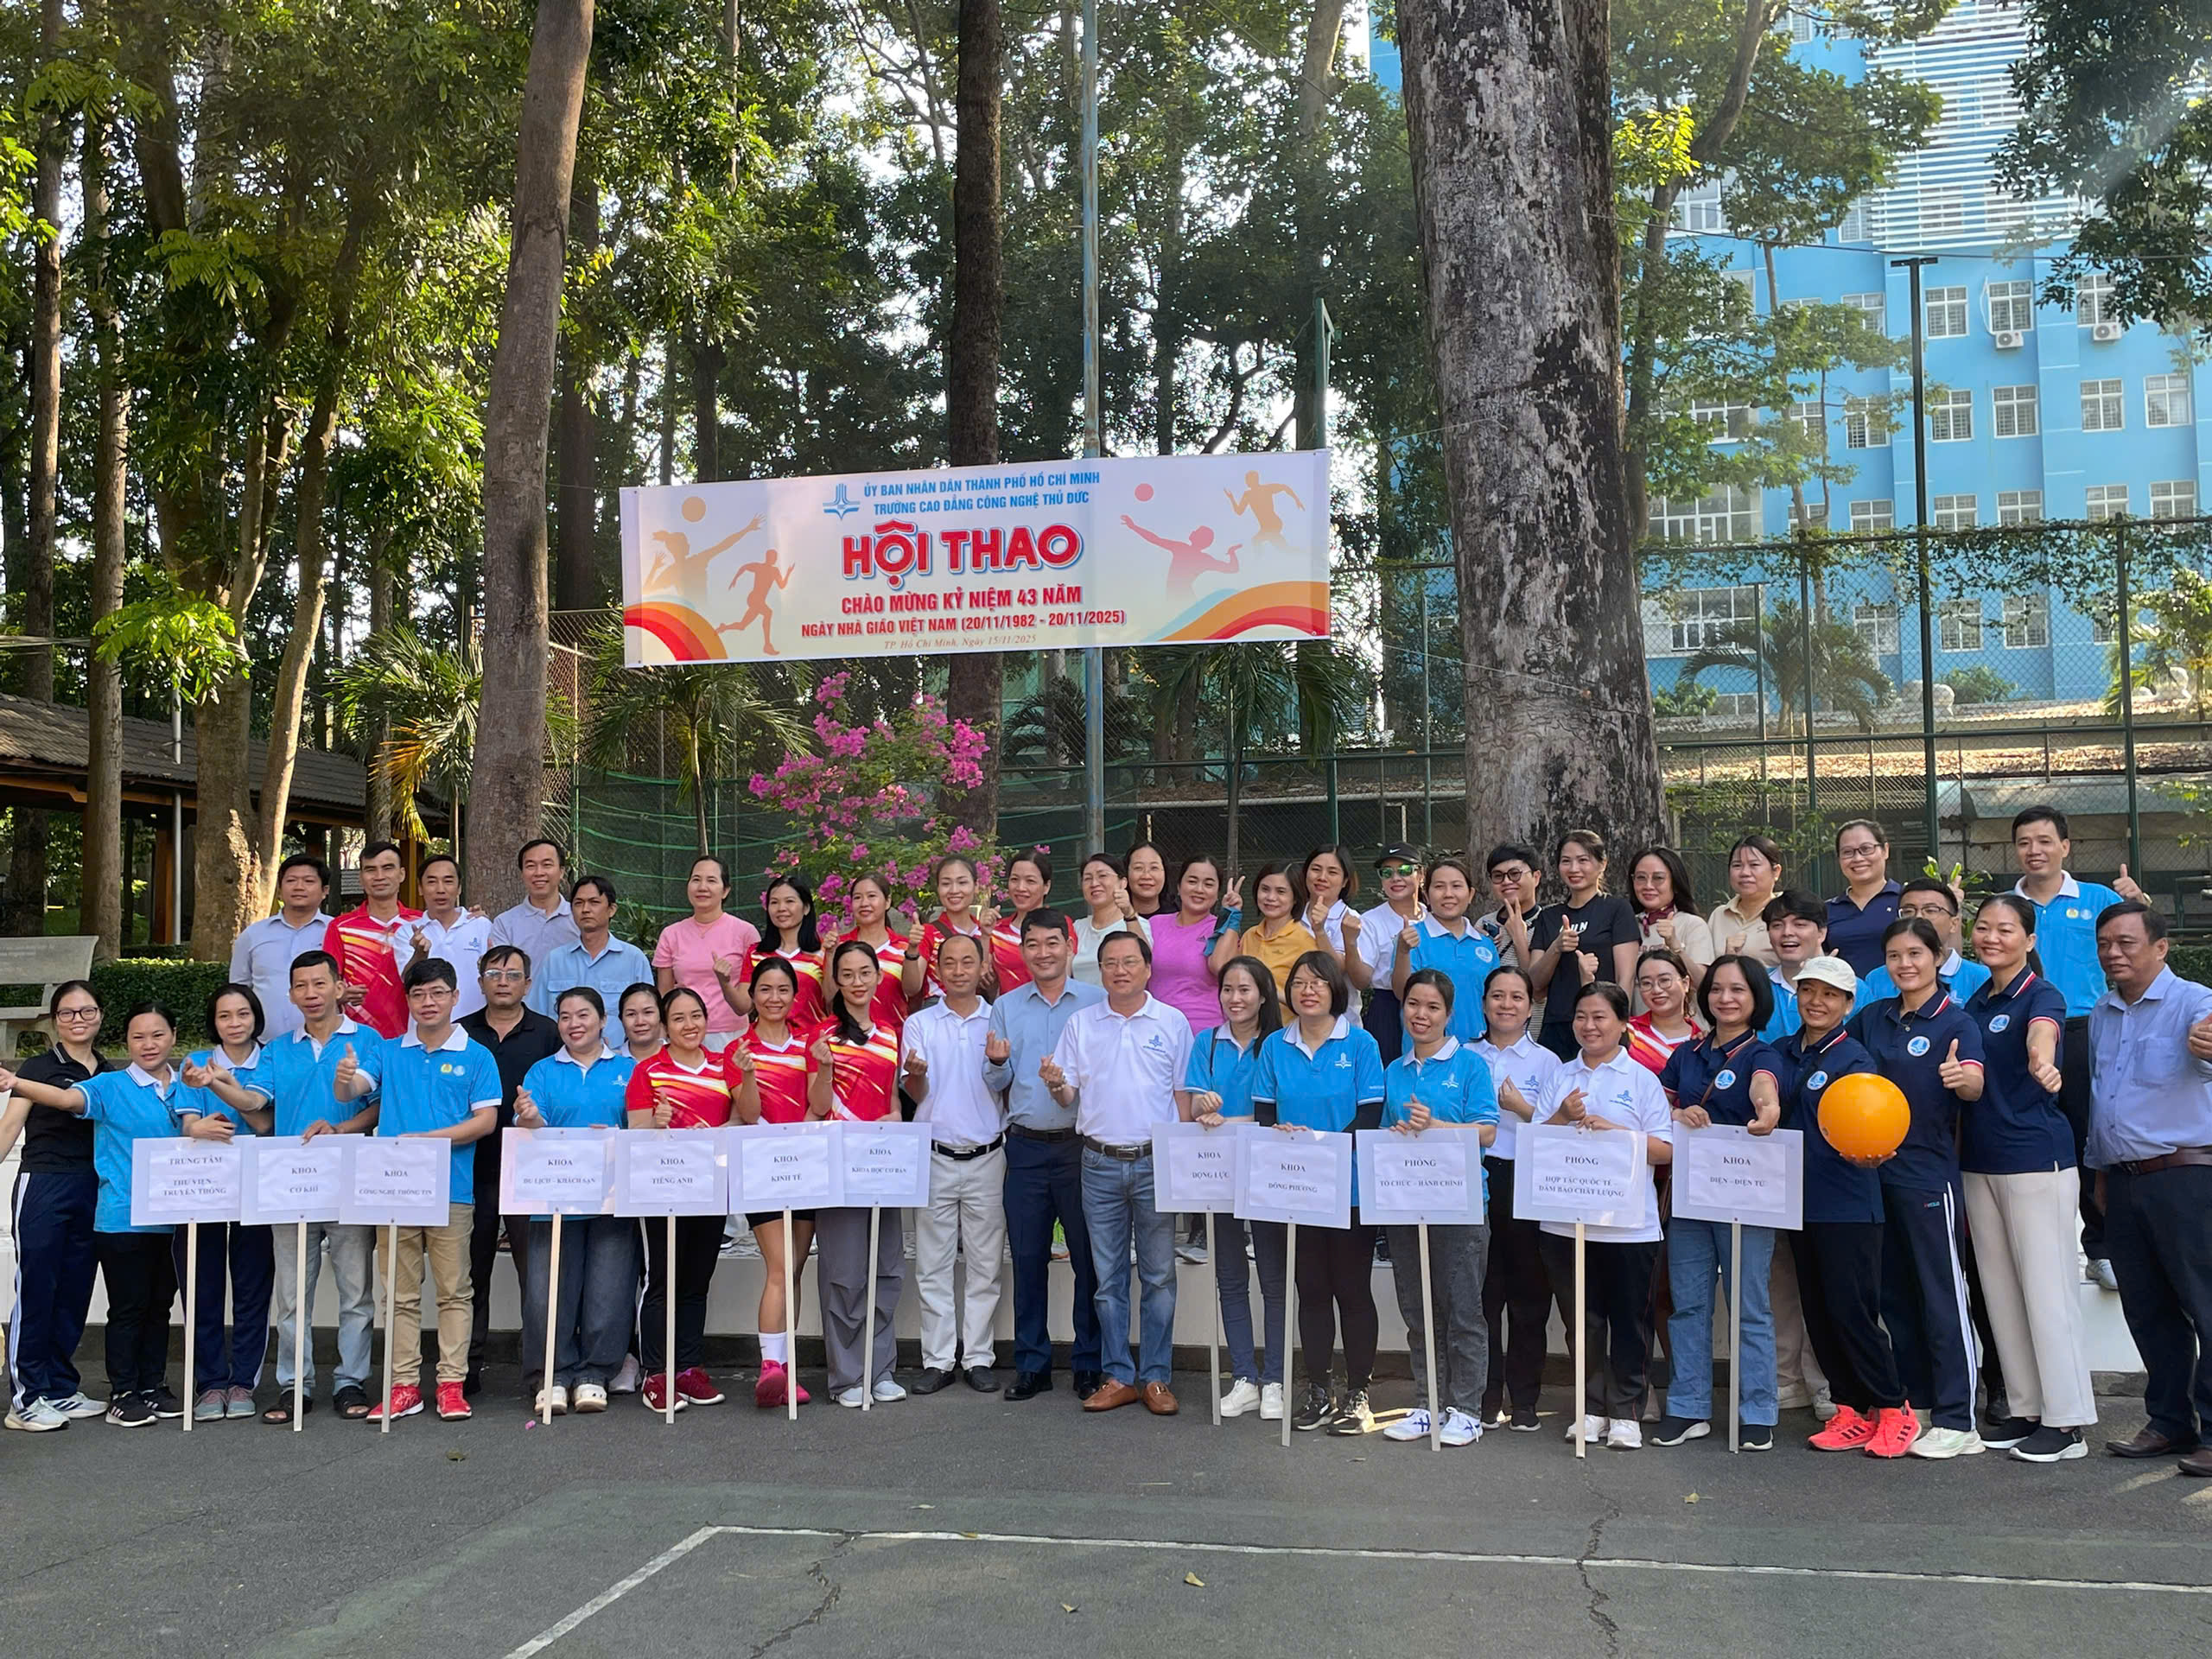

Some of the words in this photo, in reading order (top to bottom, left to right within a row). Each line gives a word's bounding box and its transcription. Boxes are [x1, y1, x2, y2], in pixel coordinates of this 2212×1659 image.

[864, 482, 877, 497] ỦY
[880, 483, 902, 496] BAN
[906, 480, 936, 495] NHÂN
[939, 479, 962, 493] DÂN
[965, 477, 1001, 491] THÀNH
[1004, 473, 1026, 489] PHỐ
[1029, 472, 1044, 487] HỒ
[1047, 471, 1066, 486] CHÍ
[1070, 472, 1100, 485] MINH
[874, 499, 916, 516] TRƯỜNG
[919, 499, 940, 512] CAO
[976, 494, 1007, 509] CÔNG
[1010, 492, 1039, 509] NGHỆ
[1042, 489, 1063, 505] THỦ
[1066, 490, 1090, 504] ĐỨC
[842, 519, 933, 590] HỘI
[939, 523, 1084, 574] THAO
[842, 594, 884, 614] CHÀO
[889, 591, 937, 612] MỪNG
[943, 587, 964, 609] KỶ
[969, 587, 1011, 612] NIỆM
[1017, 588, 1037, 606] 43
[1042, 583, 1082, 605] NĂM
[801, 620, 833, 637] NGÀY
[837, 620, 862, 635] NHÀ
[867, 619, 894, 634] GIÁO
[899, 616, 925, 635] VIỆT
[928, 618, 957, 632] NAM
[961, 614, 1035, 632] (20/11/1982
[1049, 610, 1126, 626] 20/11/2025)
[170, 1157, 200, 1166] TRUNG
[773, 1154, 798, 1163] KHOA
[1198, 1151, 1221, 1160] KHOA
[1723, 1156, 1751, 1166] KHOA
[1281, 1163, 1306, 1173] KHOA
